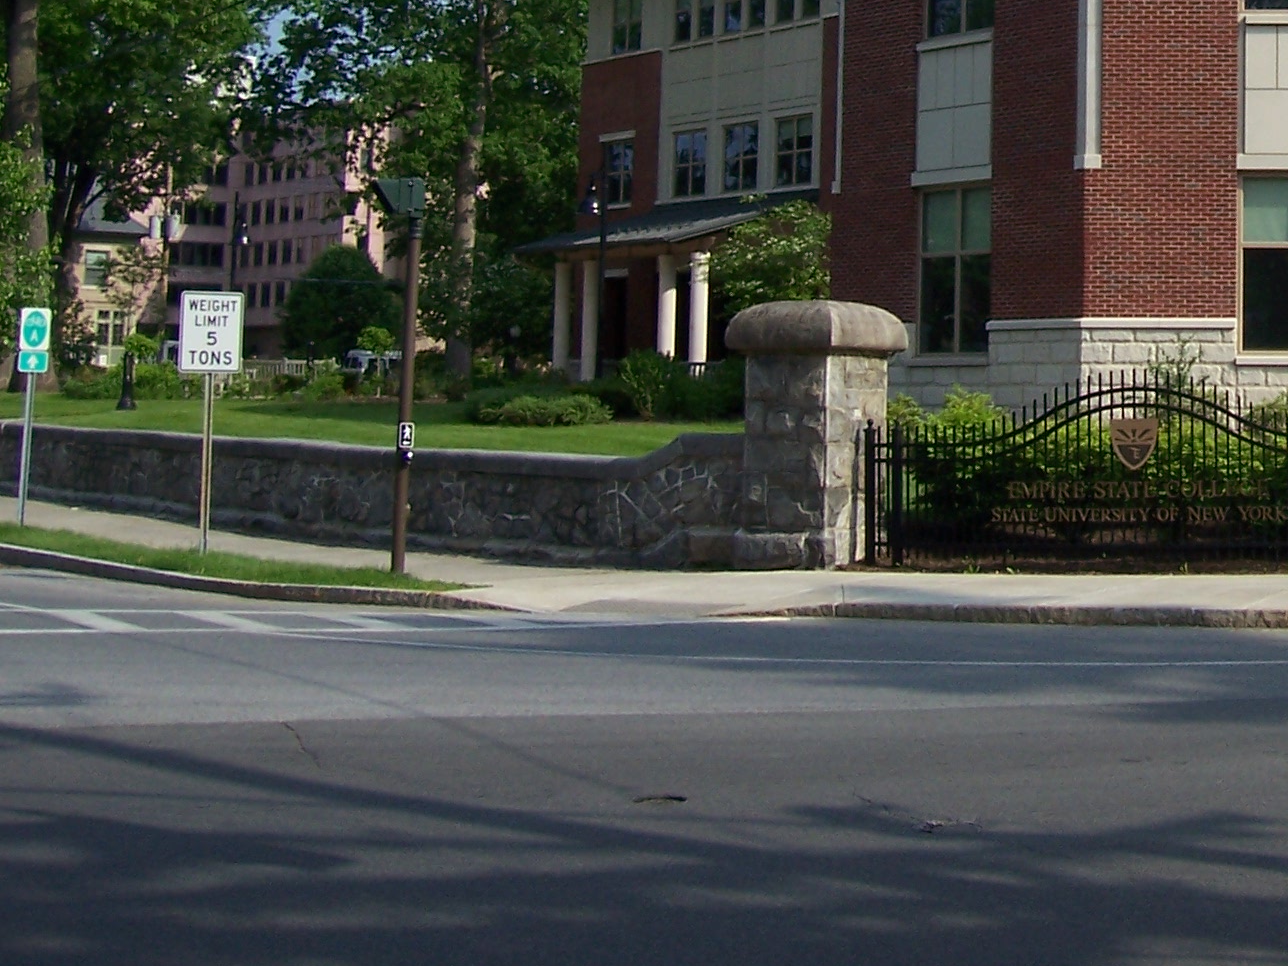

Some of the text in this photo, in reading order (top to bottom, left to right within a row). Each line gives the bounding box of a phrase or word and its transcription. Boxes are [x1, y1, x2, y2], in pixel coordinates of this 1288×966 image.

[189, 299, 238, 312] WEIGHT
[194, 315, 228, 327] LIMIT
[207, 331, 218, 346] 5
[188, 350, 232, 365] TONS
[1006, 480, 1086, 499] EMPIRE
[1093, 480, 1157, 499] STATE
[991, 506, 1039, 523] STATE
[1043, 506, 1150, 523] UNIVERSITY
[1156, 506, 1179, 522] OF
[1187, 506, 1231, 523] NEW
